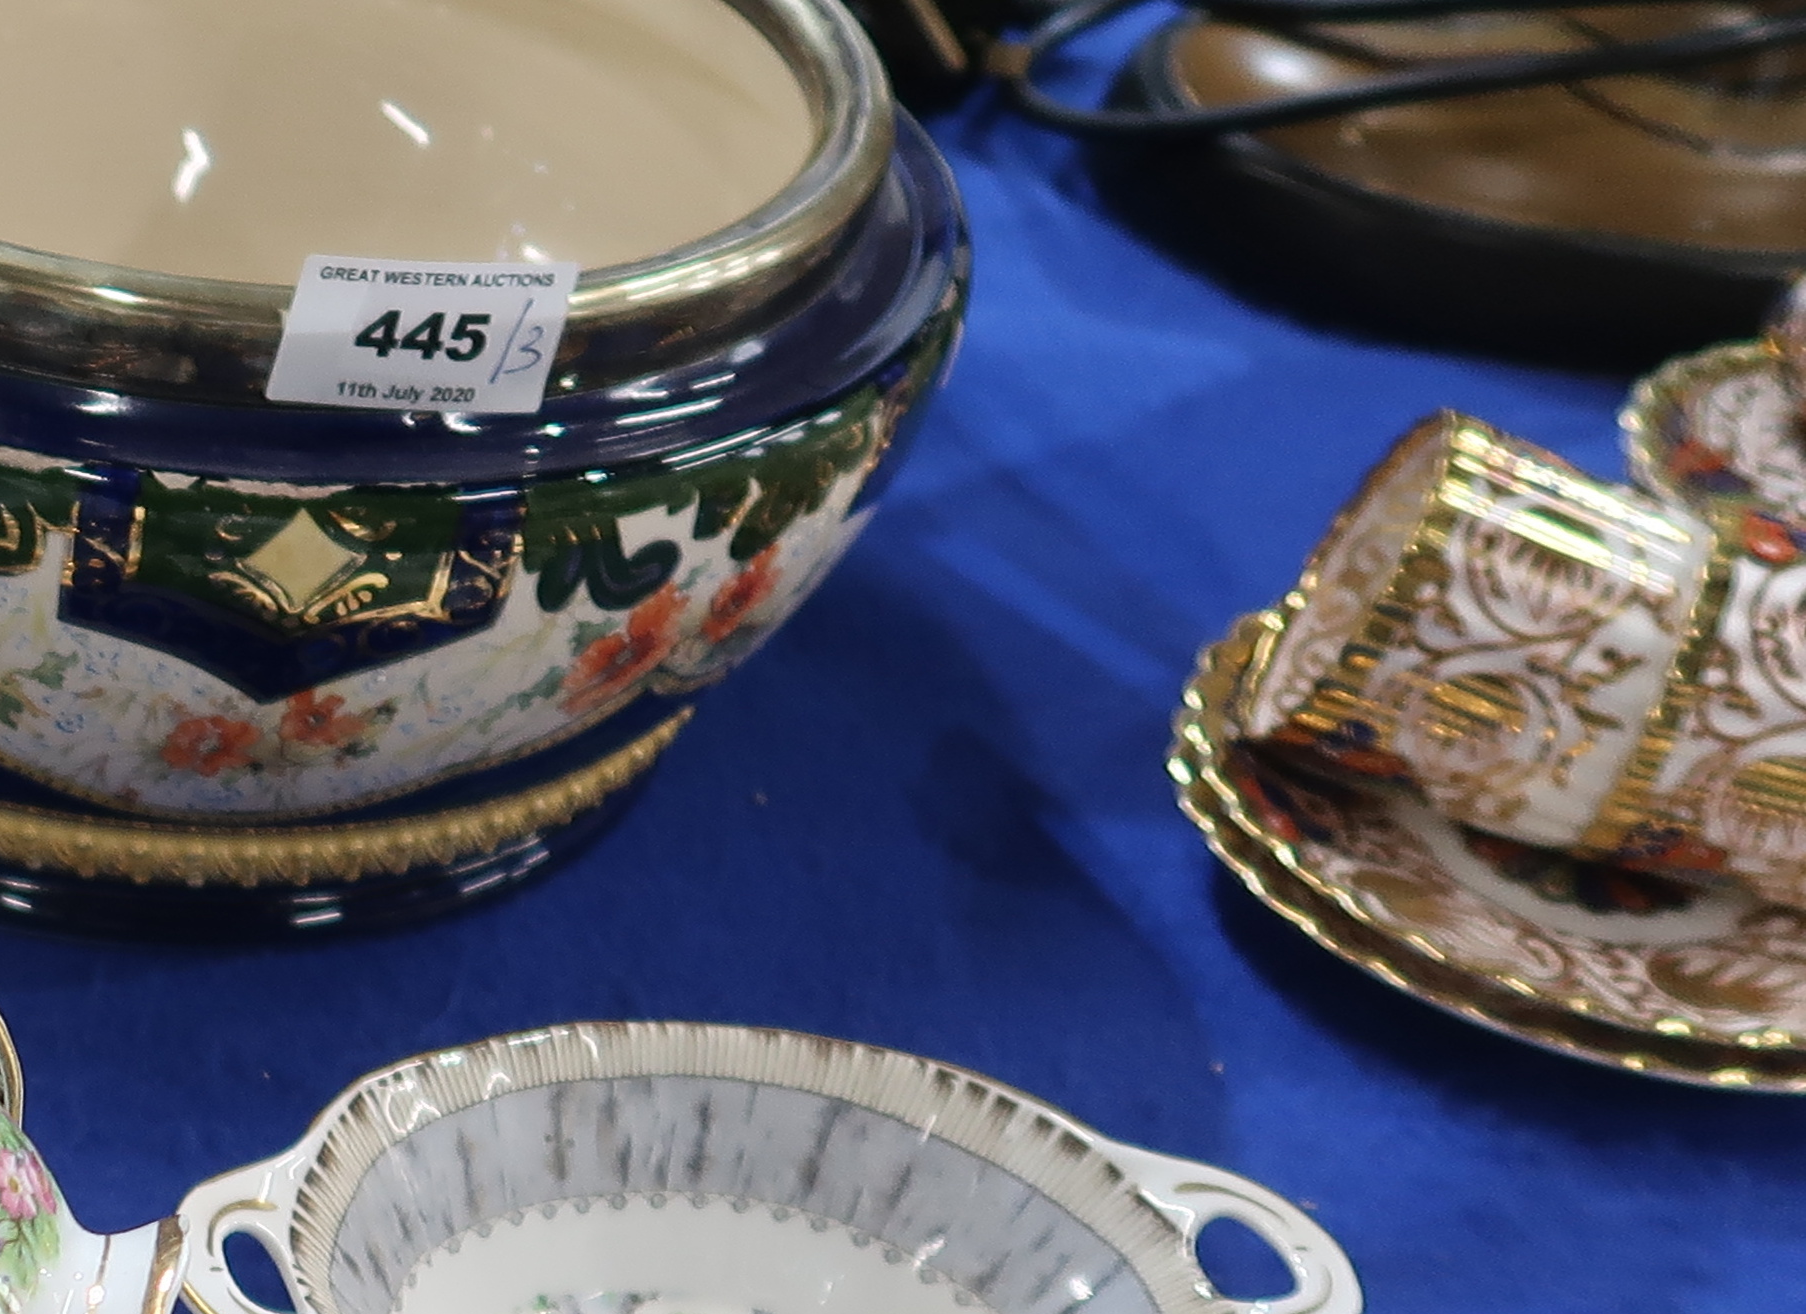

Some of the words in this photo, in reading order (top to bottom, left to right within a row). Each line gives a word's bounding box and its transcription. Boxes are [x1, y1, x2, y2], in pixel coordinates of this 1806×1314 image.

[320, 265, 380, 282] GREAT
[384, 270, 467, 287] WESTERN
[471, 272, 555, 288] AUCTIONS
[354, 309, 491, 363] 445
[337, 380, 376, 398] 11th
[382, 384, 424, 402] July
[429, 385, 476, 402] 2020
